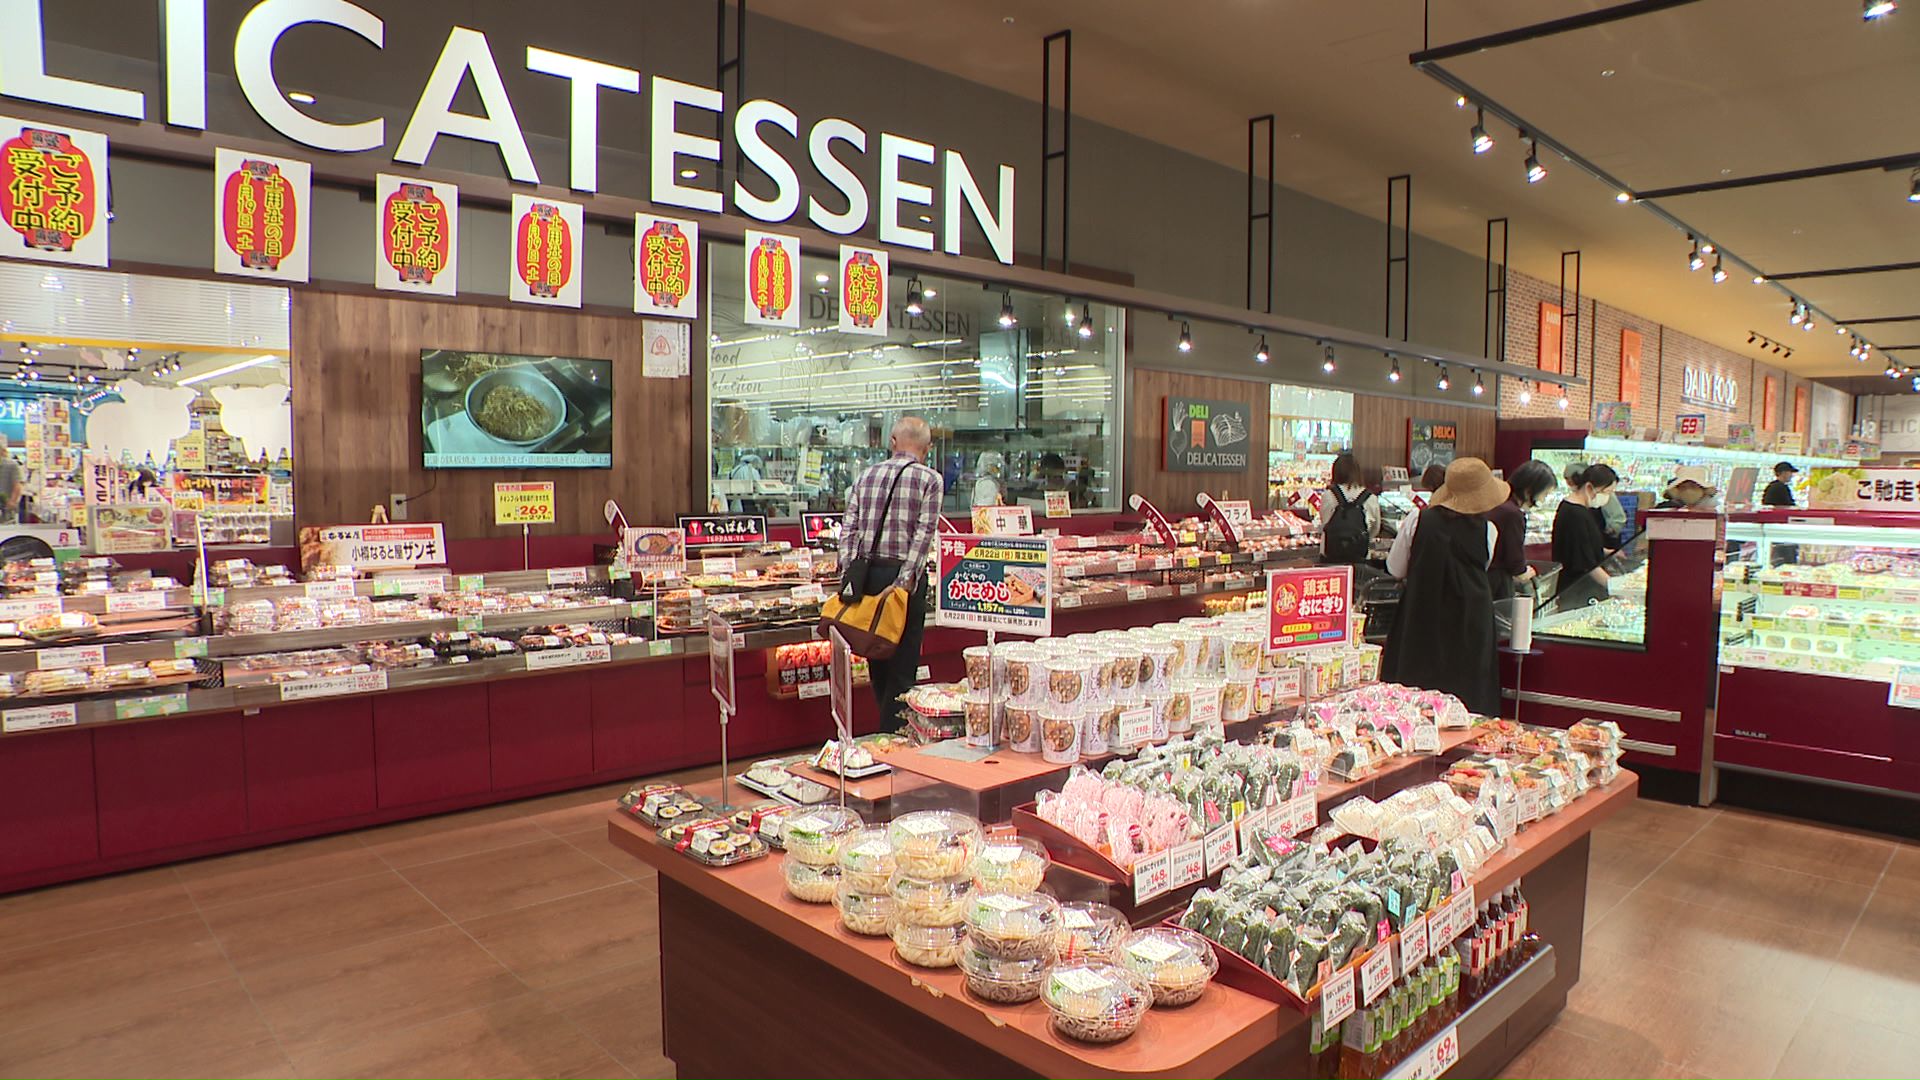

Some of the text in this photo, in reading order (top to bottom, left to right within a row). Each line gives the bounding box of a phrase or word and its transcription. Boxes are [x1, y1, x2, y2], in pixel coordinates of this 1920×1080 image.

[8, 147, 45, 231] 受付中
[48, 153, 84, 239] ご予約
[264, 173, 283, 258] 土用丑の日
[391, 200, 415, 268] 受付中
[416, 202, 440, 273] ご予約
[547, 214, 563, 287] 土用丑の日
[647, 236, 665, 295] 受付中
[666, 237, 686, 299] ご予約
[848, 263, 863, 316] 受付中
[863, 264, 878, 320] ご予約
[1684, 366, 1738, 406] DAILY FOOD
[1189, 404, 1209, 419] DELI
[1433, 425, 1456, 439] DELICA
[1187, 452, 1247, 467] DELICATESSEN
[519, 505, 549, 515] 269
[1224, 508, 1248, 520] フライ
[703, 519, 758, 535] てっぱん屋
[352, 540, 437, 561] 小樽なると屋ザンギ
[941, 540, 966, 557] 予告
[954, 571, 987, 581] かなやの
[1303, 577, 1341, 596] 鶏五目
[949, 579, 1010, 602] かにめし
[1298, 595, 1344, 617] おにぎり
[1151, 868, 1166, 884] 148
